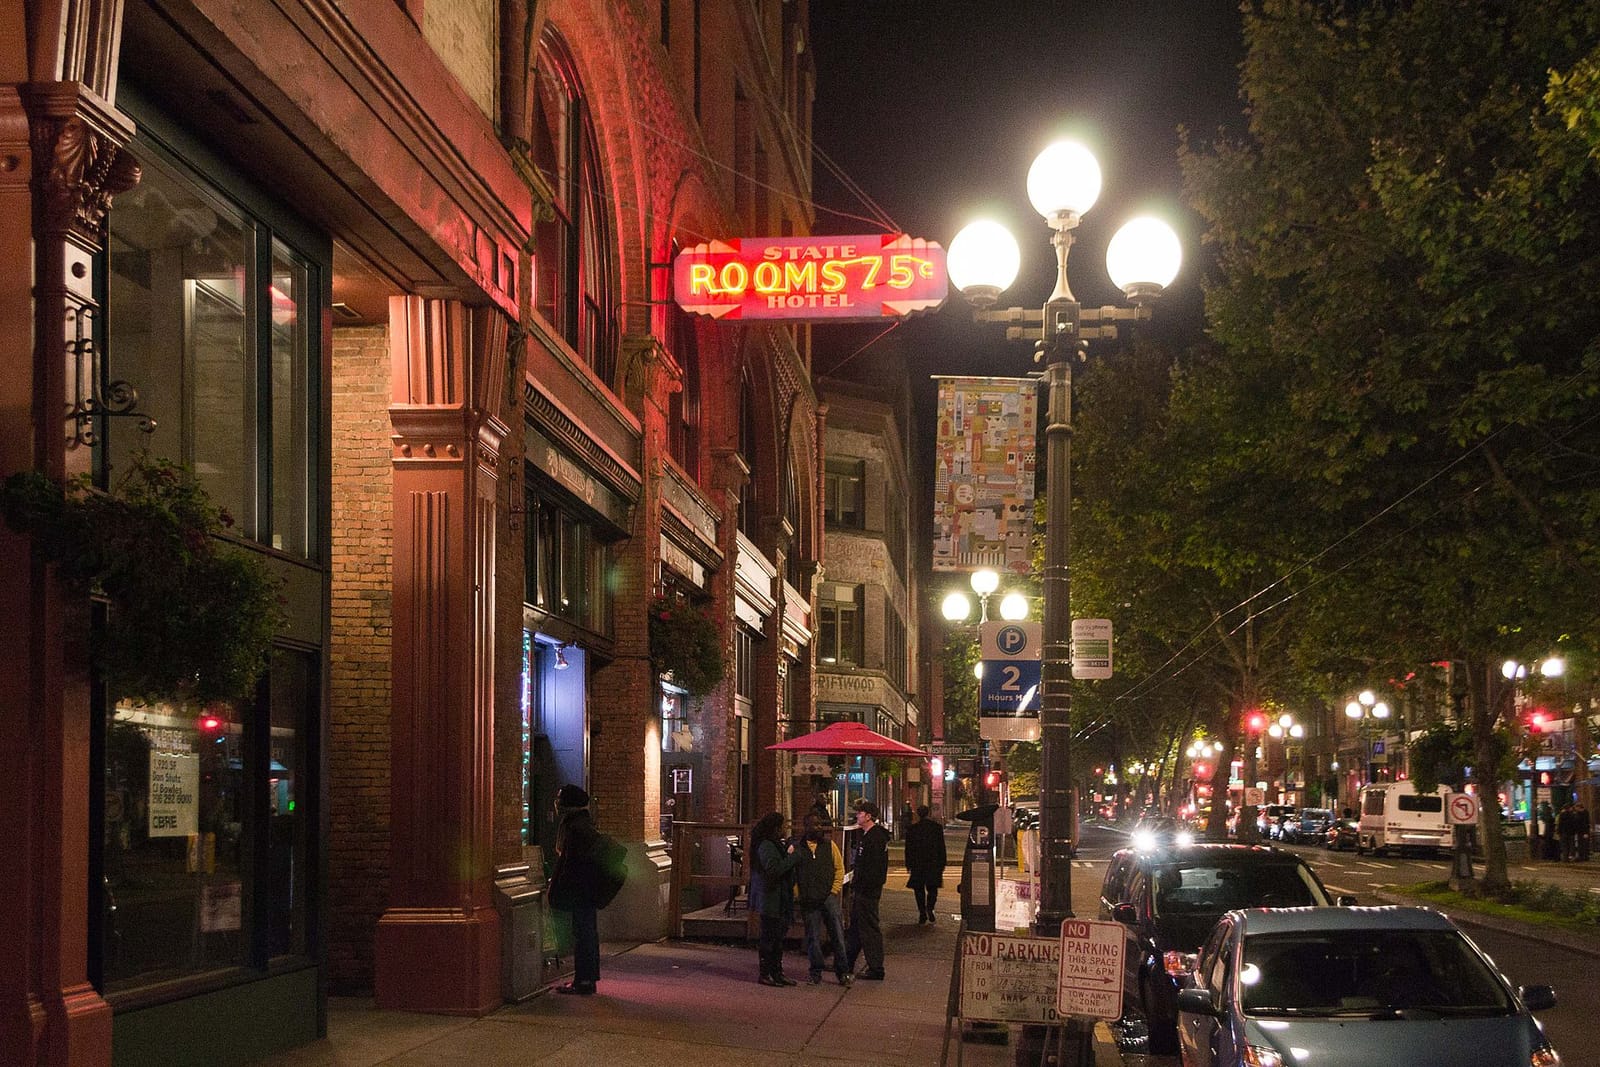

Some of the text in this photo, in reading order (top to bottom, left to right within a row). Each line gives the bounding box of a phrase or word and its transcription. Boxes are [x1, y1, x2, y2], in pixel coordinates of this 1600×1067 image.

[763, 245, 857, 260] STATE
[690, 261, 846, 295] ROOMS
[767, 294, 855, 309] HOTEL
[818, 675, 875, 691] RIFTWOOD
[1001, 666, 1020, 691] 2
[987, 693, 1013, 701] Hours
[152, 815, 178, 828] CBRE
[1068, 923, 1087, 937] NO
[966, 934, 1060, 961] NO PARKING
[1067, 941, 1118, 957] PARKING
[971, 961, 992, 971] FROM
[1068, 955, 1117, 967] THIS SPACE
[1069, 965, 1087, 974] 7AM
[1096, 967, 1115, 976] 6PM
[976, 977, 986, 987] TO
[970, 991, 989, 1001] TOW
[1000, 993, 1028, 1003] AWAY
[1079, 998, 1101, 1007] ZONE
